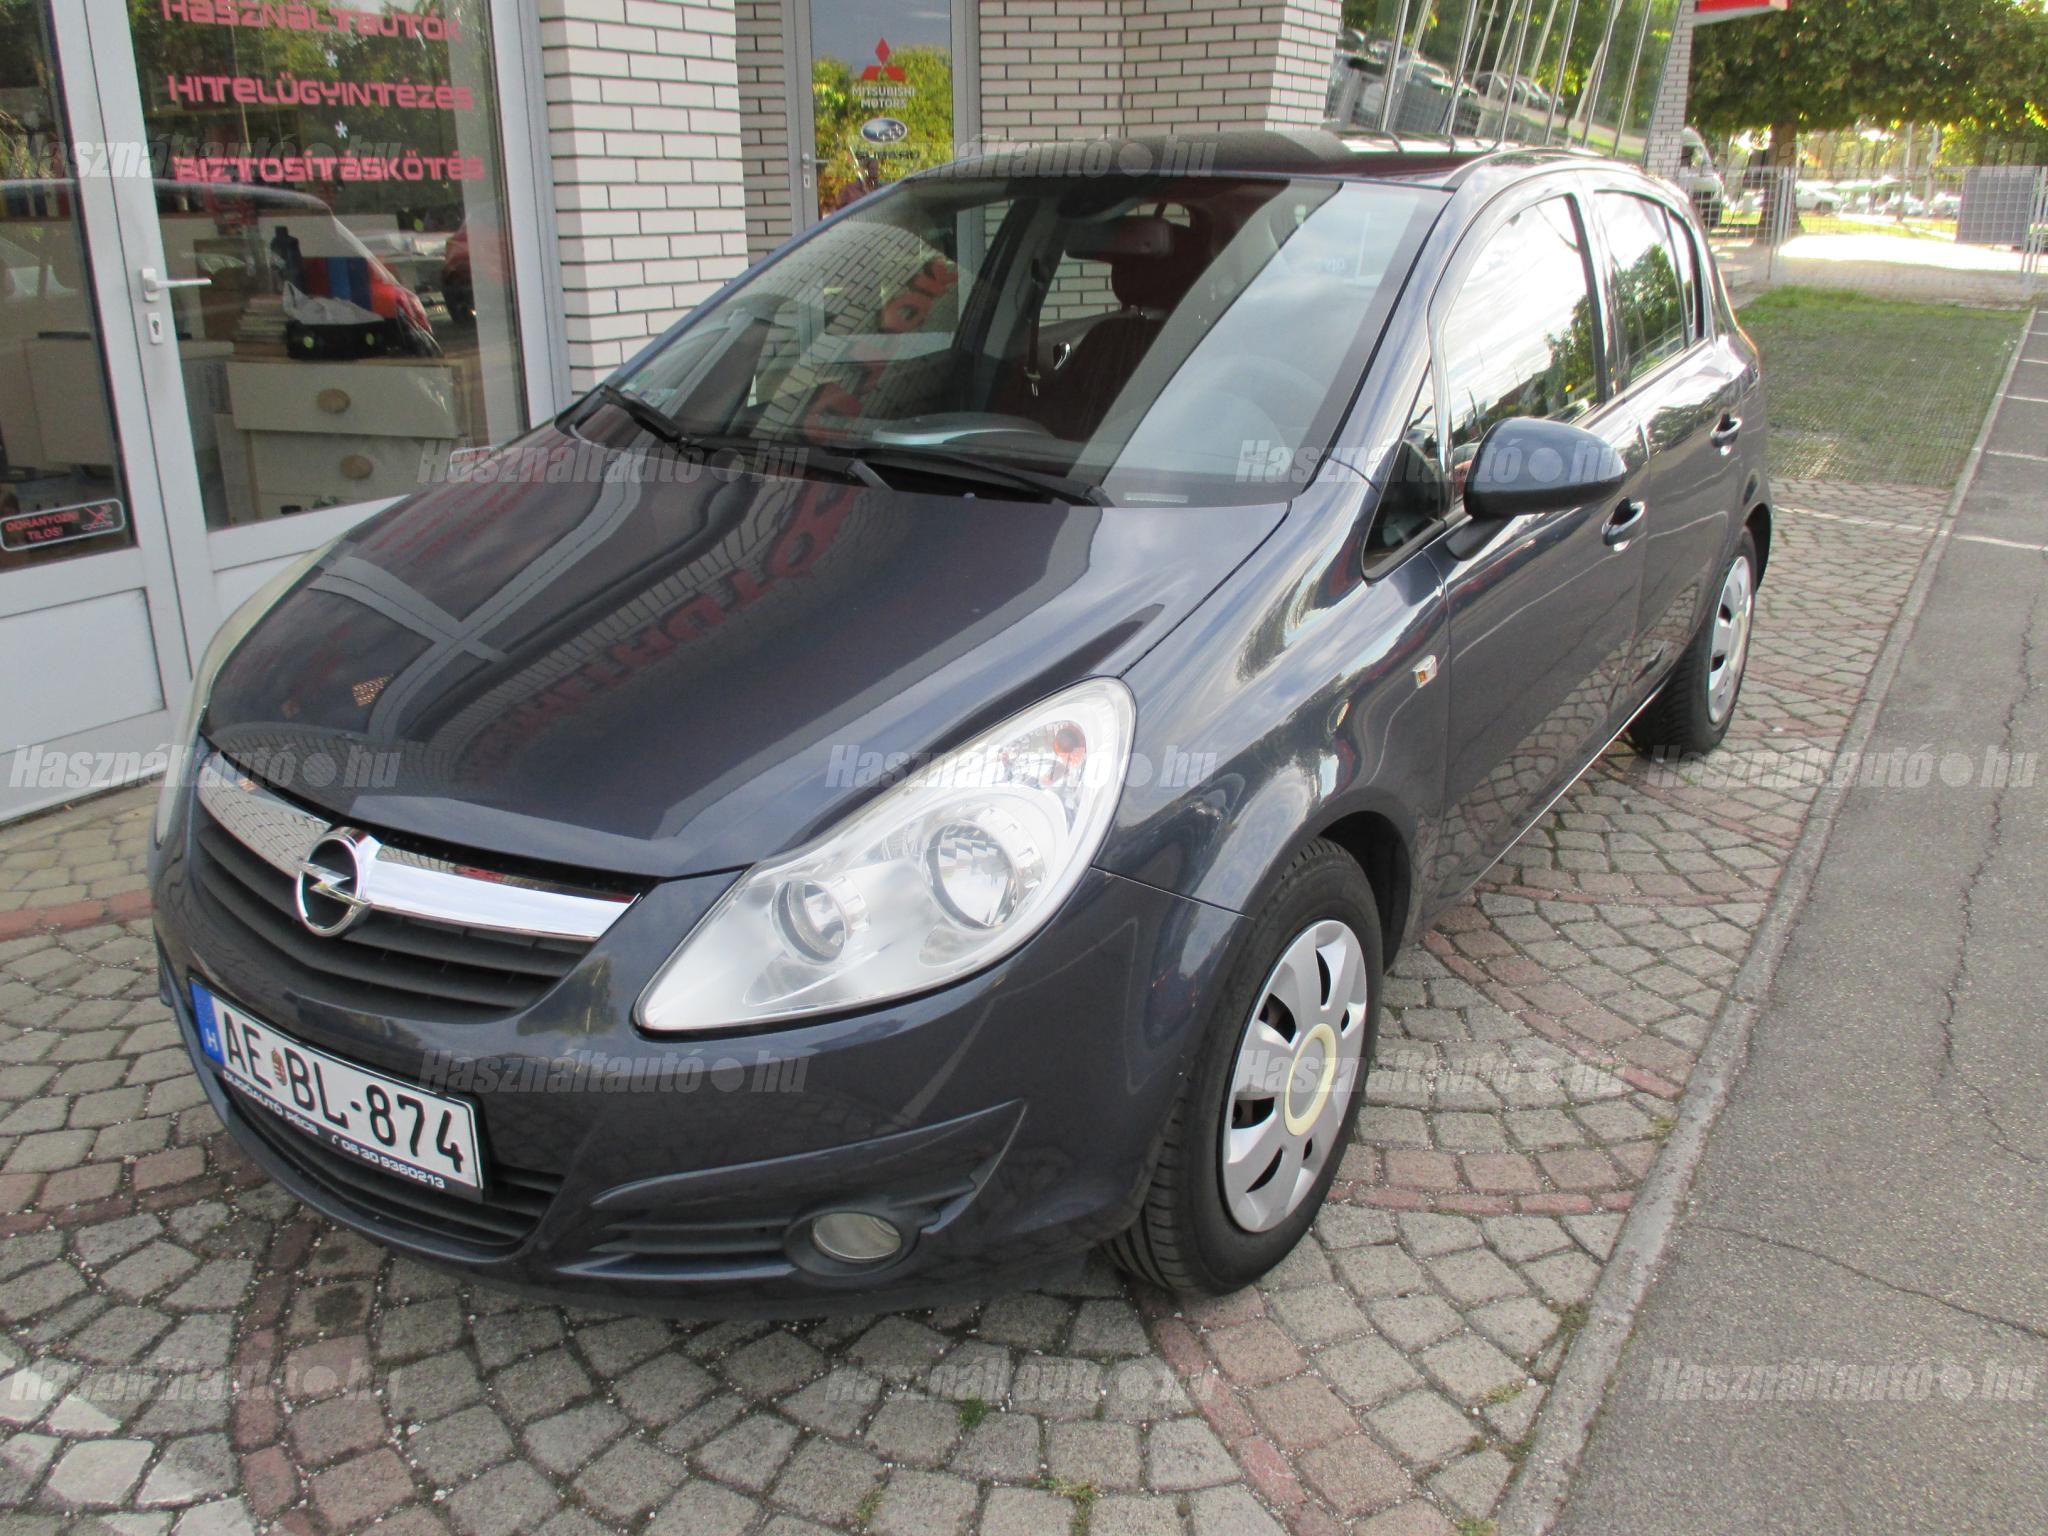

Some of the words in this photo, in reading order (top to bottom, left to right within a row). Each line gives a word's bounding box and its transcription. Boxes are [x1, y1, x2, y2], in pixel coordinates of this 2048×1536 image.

[852, 86, 915, 97] MITSUBISHI
[860, 98, 908, 109] MOTORS
[207, 1028, 219, 1052] H
